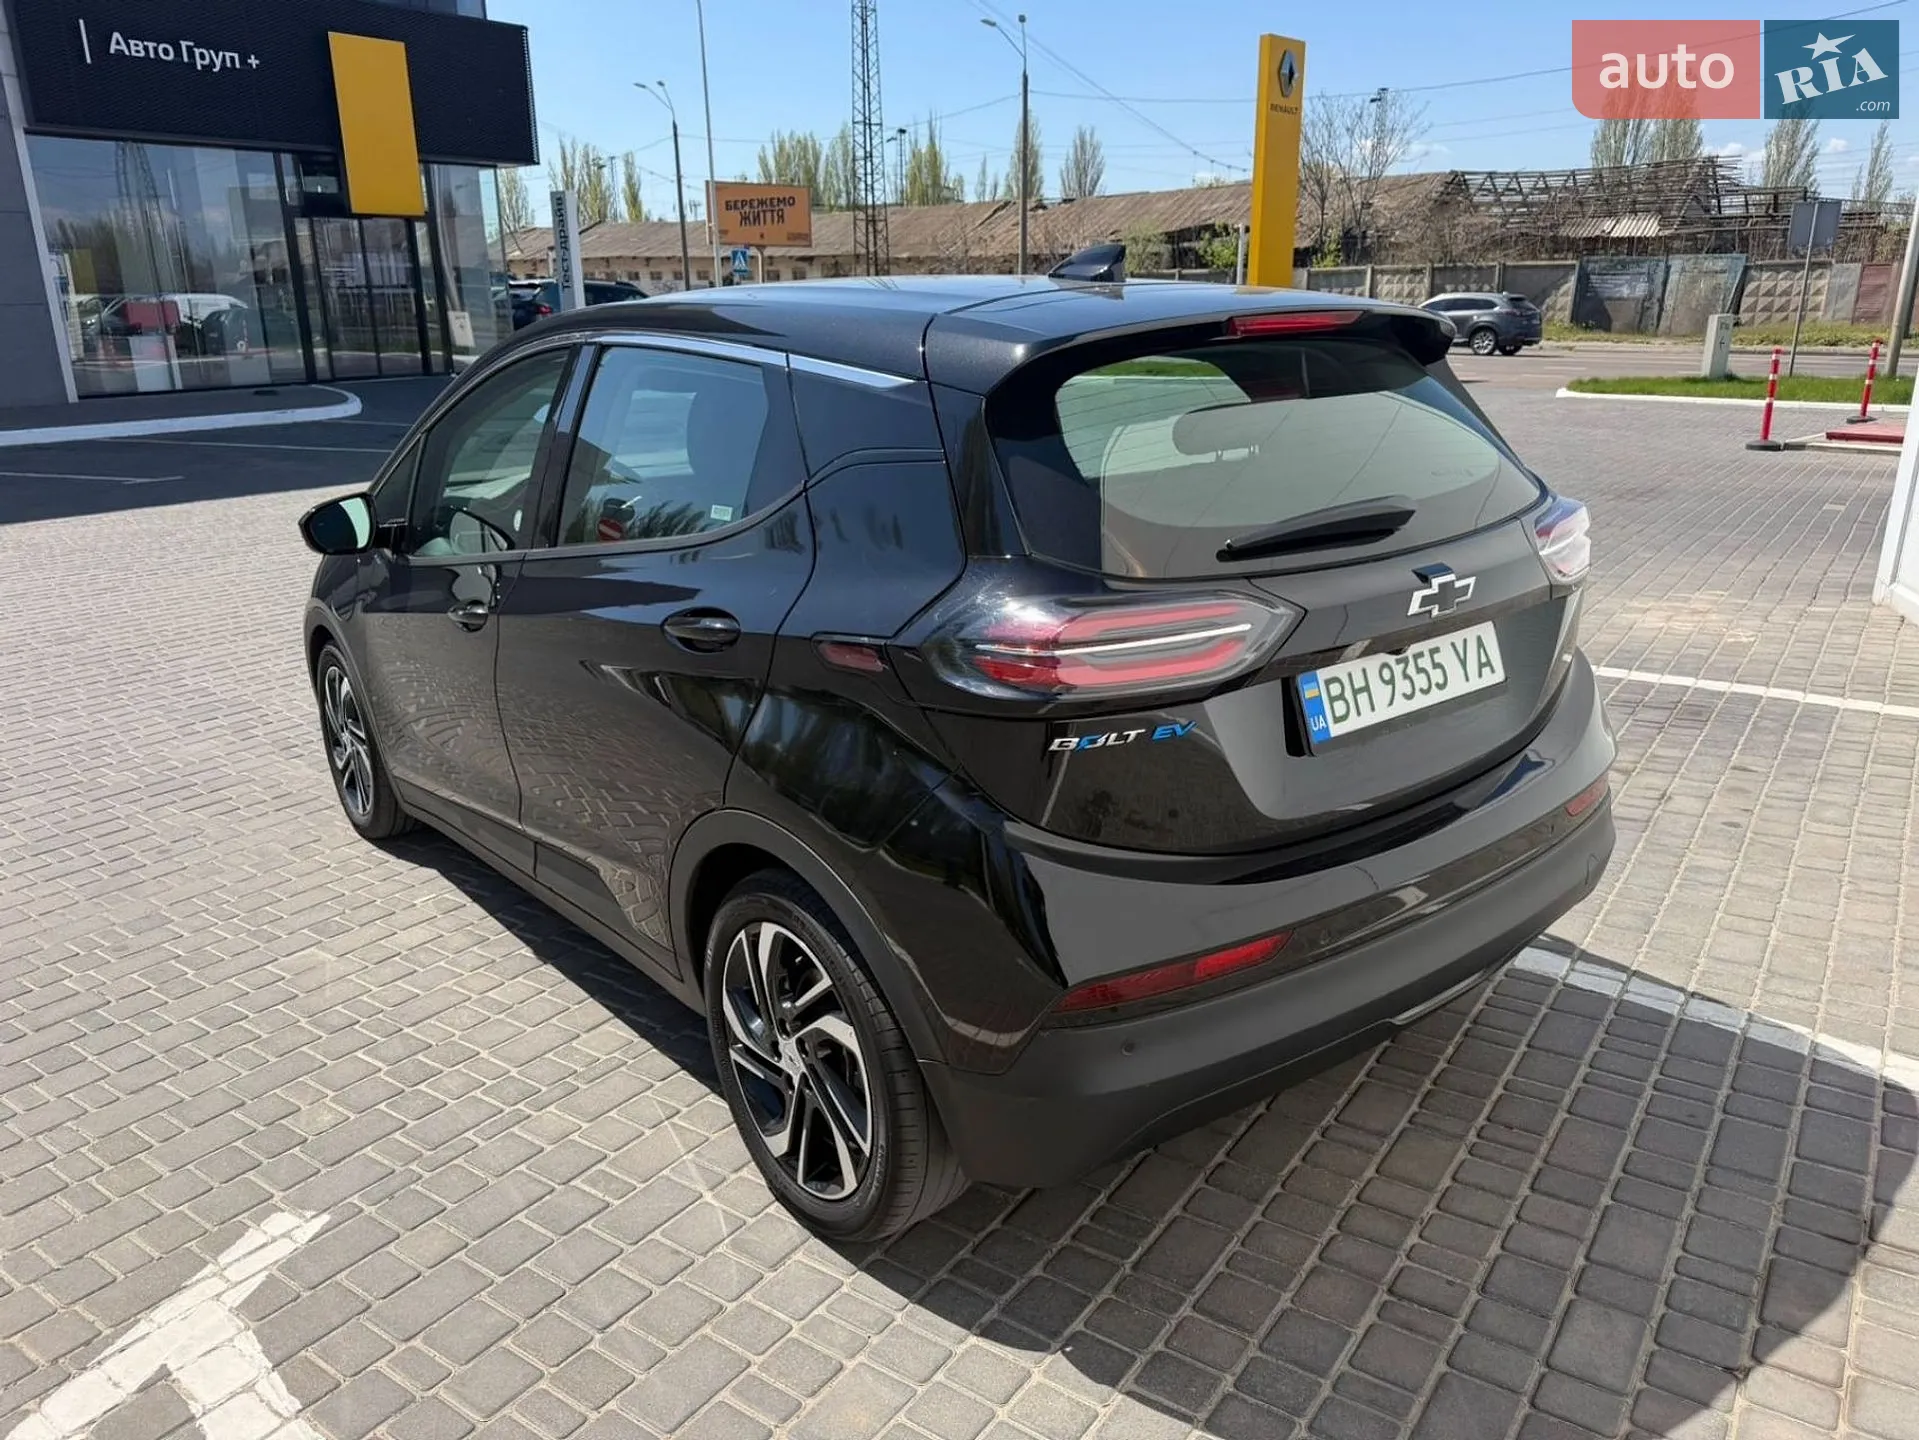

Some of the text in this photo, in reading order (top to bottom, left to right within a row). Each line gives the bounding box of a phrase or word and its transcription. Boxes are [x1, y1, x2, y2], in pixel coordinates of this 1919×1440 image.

[109, 31, 175, 61] Авто
[179, 40, 241, 72] Груп
[725, 196, 796, 211] БЕРЕЖЕМО
[739, 208, 785, 227] ЖИТТЯ
[1323, 634, 1496, 725] BH 9355 YA
[1048, 720, 1197, 751] BOLT EV
[1311, 715, 1327, 731] UA
